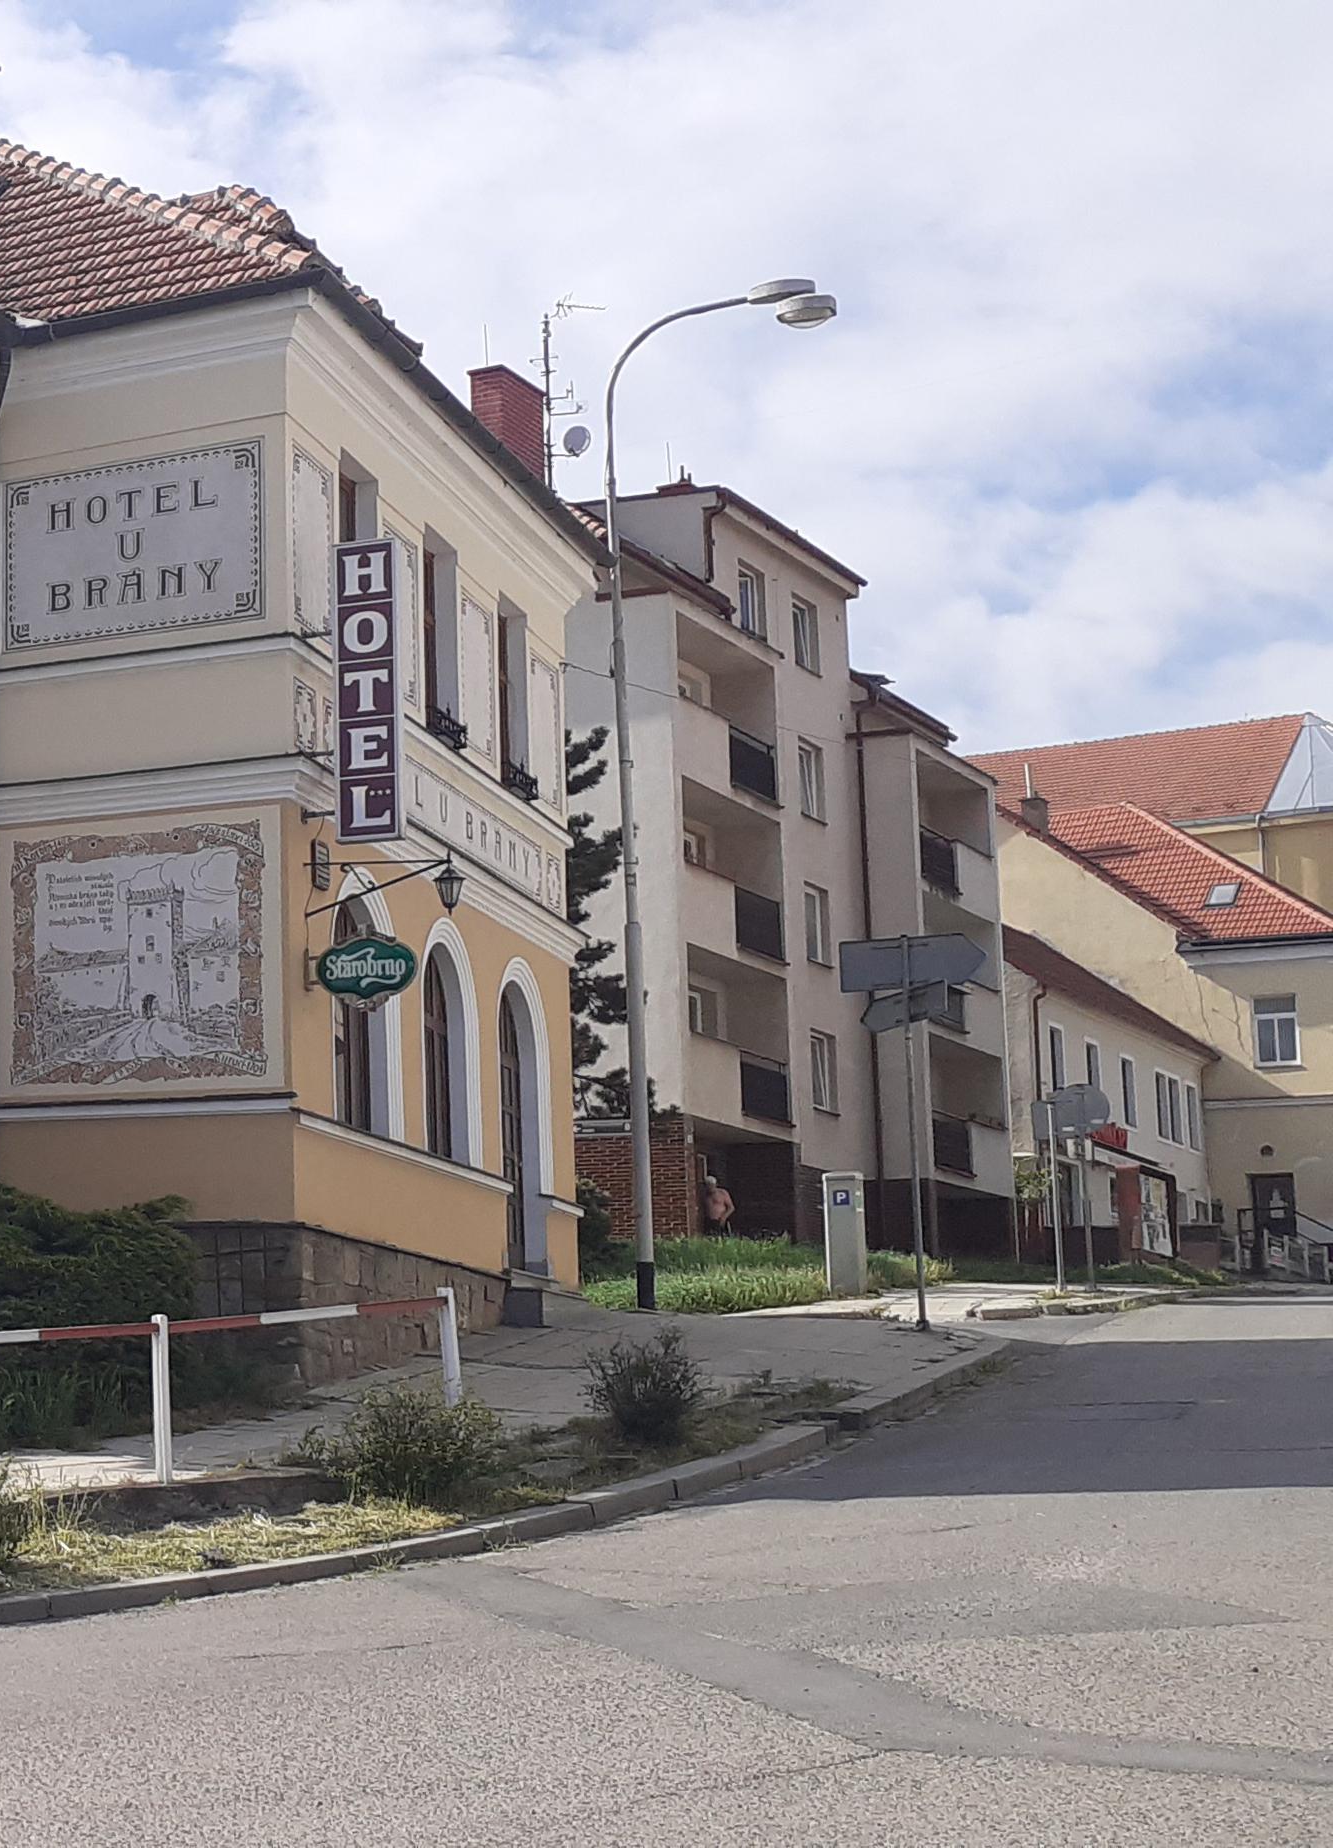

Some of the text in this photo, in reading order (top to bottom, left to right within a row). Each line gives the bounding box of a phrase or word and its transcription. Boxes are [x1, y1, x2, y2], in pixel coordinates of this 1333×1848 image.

[46, 476, 219, 534] HOTEL
[115, 527, 146, 563] U
[46, 557, 223, 615] BRÁNY
[341, 550, 393, 830] HOTEL
[325, 947, 406, 988] Starobrno
[836, 1192, 847, 1204] P
